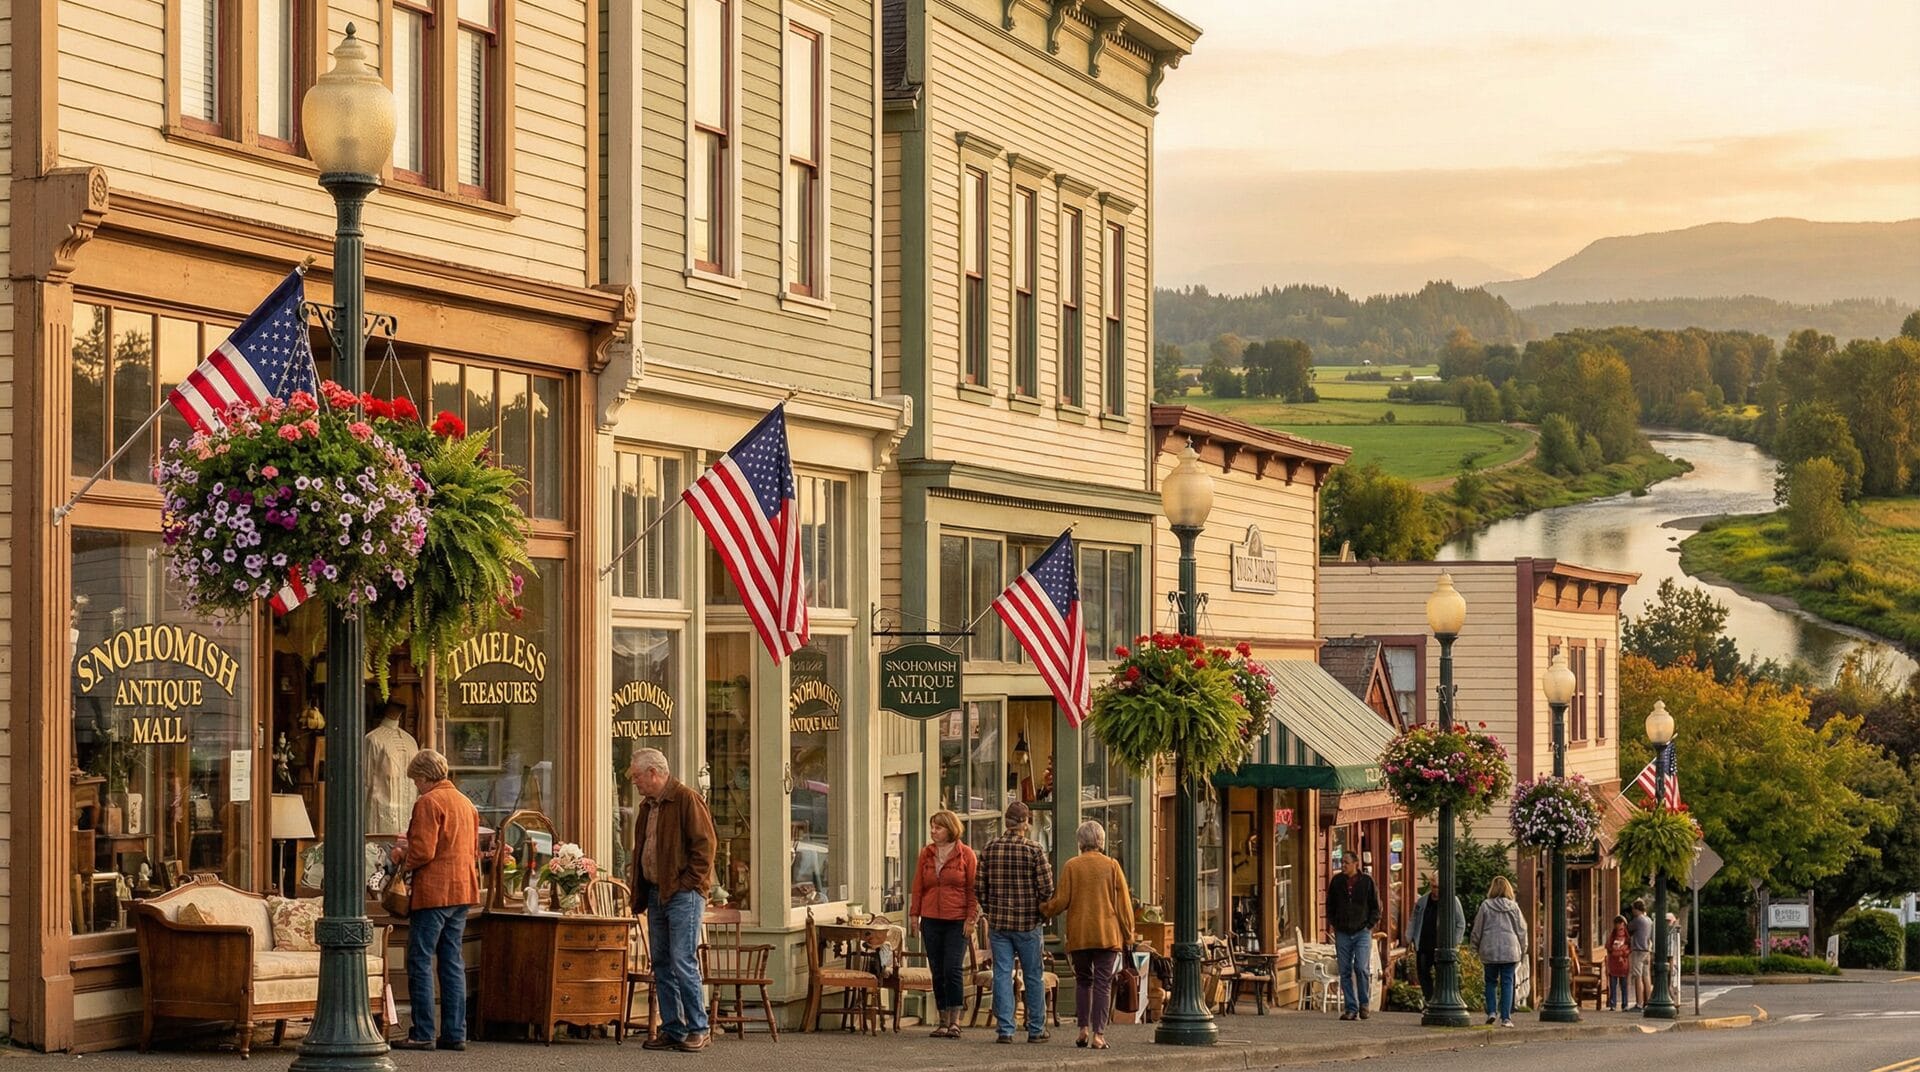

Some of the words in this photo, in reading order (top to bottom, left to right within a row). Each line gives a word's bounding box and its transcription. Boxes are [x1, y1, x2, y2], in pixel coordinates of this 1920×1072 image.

[77, 624, 239, 696] SNOHOMISH
[447, 631, 547, 682] TIMELESS
[885, 660, 957, 672] SNOHOMISH
[460, 681, 537, 704] TREASURES
[887, 674, 955, 690] ANTIQUE
[114, 679, 203, 711] ANTIQUE
[610, 680, 674, 719] SNOHOMISH
[789, 680, 841, 715] SNOHOMISH
[900, 691, 941, 704] MALL
[132, 717, 187, 744] MALL
[612, 720, 649, 740] ANTIQUE
[649, 720, 672, 736] MALL
[790, 717, 820, 734] ANTIQUE
[820, 716, 839, 730] MALL
